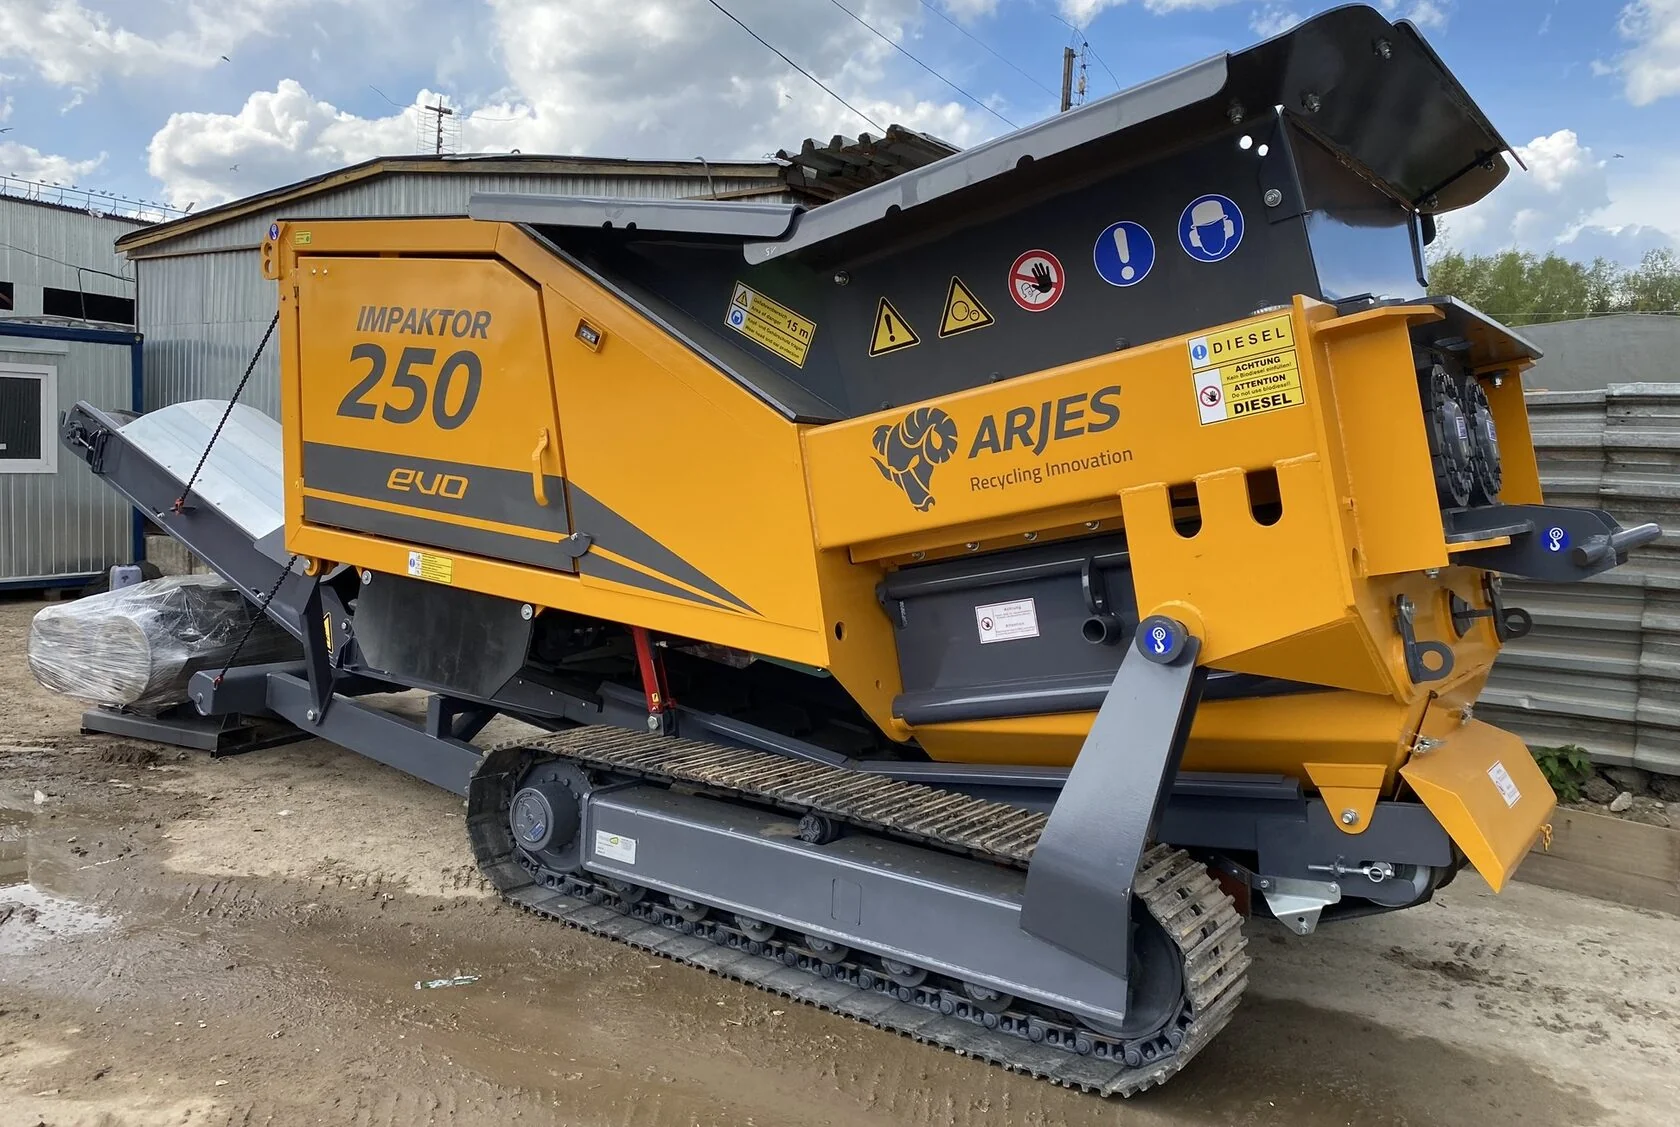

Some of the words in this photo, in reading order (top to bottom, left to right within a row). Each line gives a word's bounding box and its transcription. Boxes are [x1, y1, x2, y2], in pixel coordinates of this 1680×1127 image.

[356, 305, 492, 339] IMPAKTOR
[766, 313, 782, 326] danger
[786, 319, 798, 332] 15
[799, 328, 809, 339] m
[1213, 327, 1285, 354] DIESEL
[1235, 356, 1281, 372] ACHTUNG
[1240, 368, 1266, 379] Biodiesel
[336, 343, 482, 431] 250
[1234, 374, 1286, 391] ATTENTION
[1233, 393, 1293, 415] DIESEL
[967, 385, 1122, 459] ARJES
[970, 467, 1042, 492] Recycling
[1045, 449, 1133, 477] Innovation
[386, 467, 469, 500] evo
